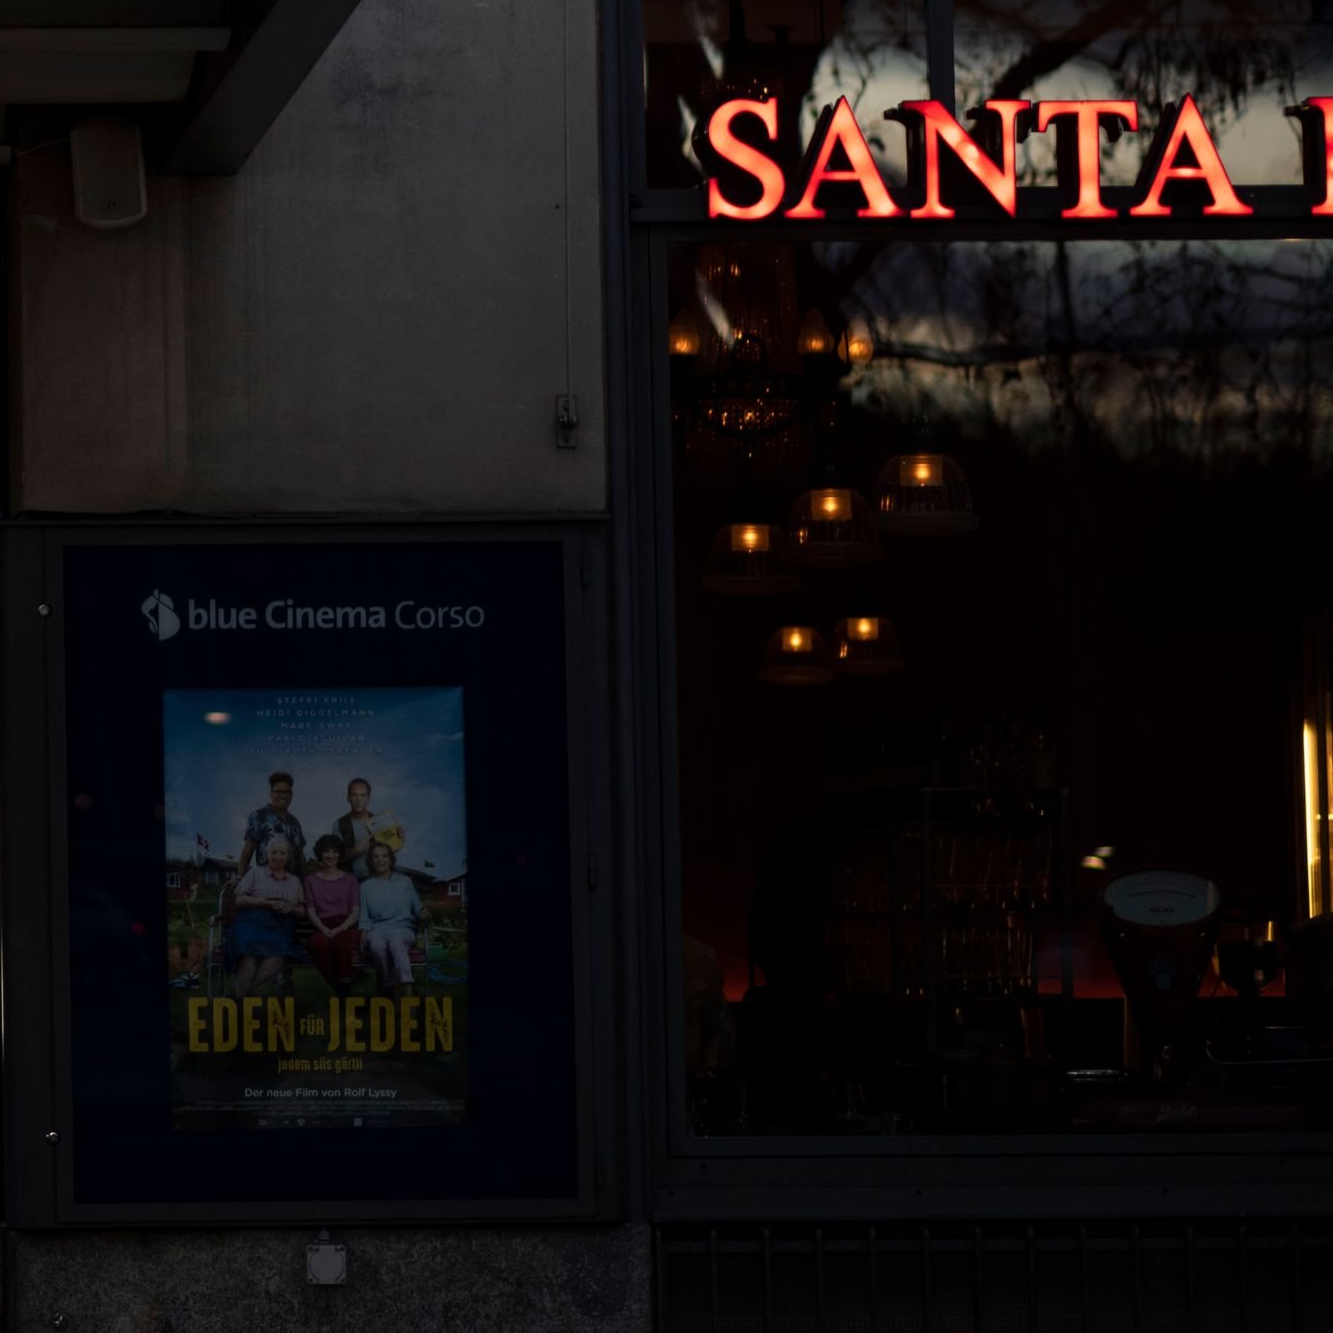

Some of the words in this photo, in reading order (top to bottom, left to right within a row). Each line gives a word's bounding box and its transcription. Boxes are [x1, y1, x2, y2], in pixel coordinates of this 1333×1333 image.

[707, 94, 1255, 219] SANTA
[189, 598, 257, 630] blue
[265, 598, 387, 630] Cinema
[394, 600, 485, 630] Corso
[257, 709, 290, 718] HEIDI
[296, 709, 374, 718] DIGGELMANN
[187, 995, 295, 1053] EDEN
[299, 1014, 325, 1037] FÜR
[327, 995, 454, 1053] JEDEN
[277, 1057, 311, 1074] jedem
[244, 1087, 264, 1098] Der
[266, 1089, 292, 1098] neue
[295, 1087, 319, 1098] Film
[321, 1089, 341, 1098] von
[344, 1087, 366, 1098] Rolf
[368, 1087, 398, 1100] Lyssy
